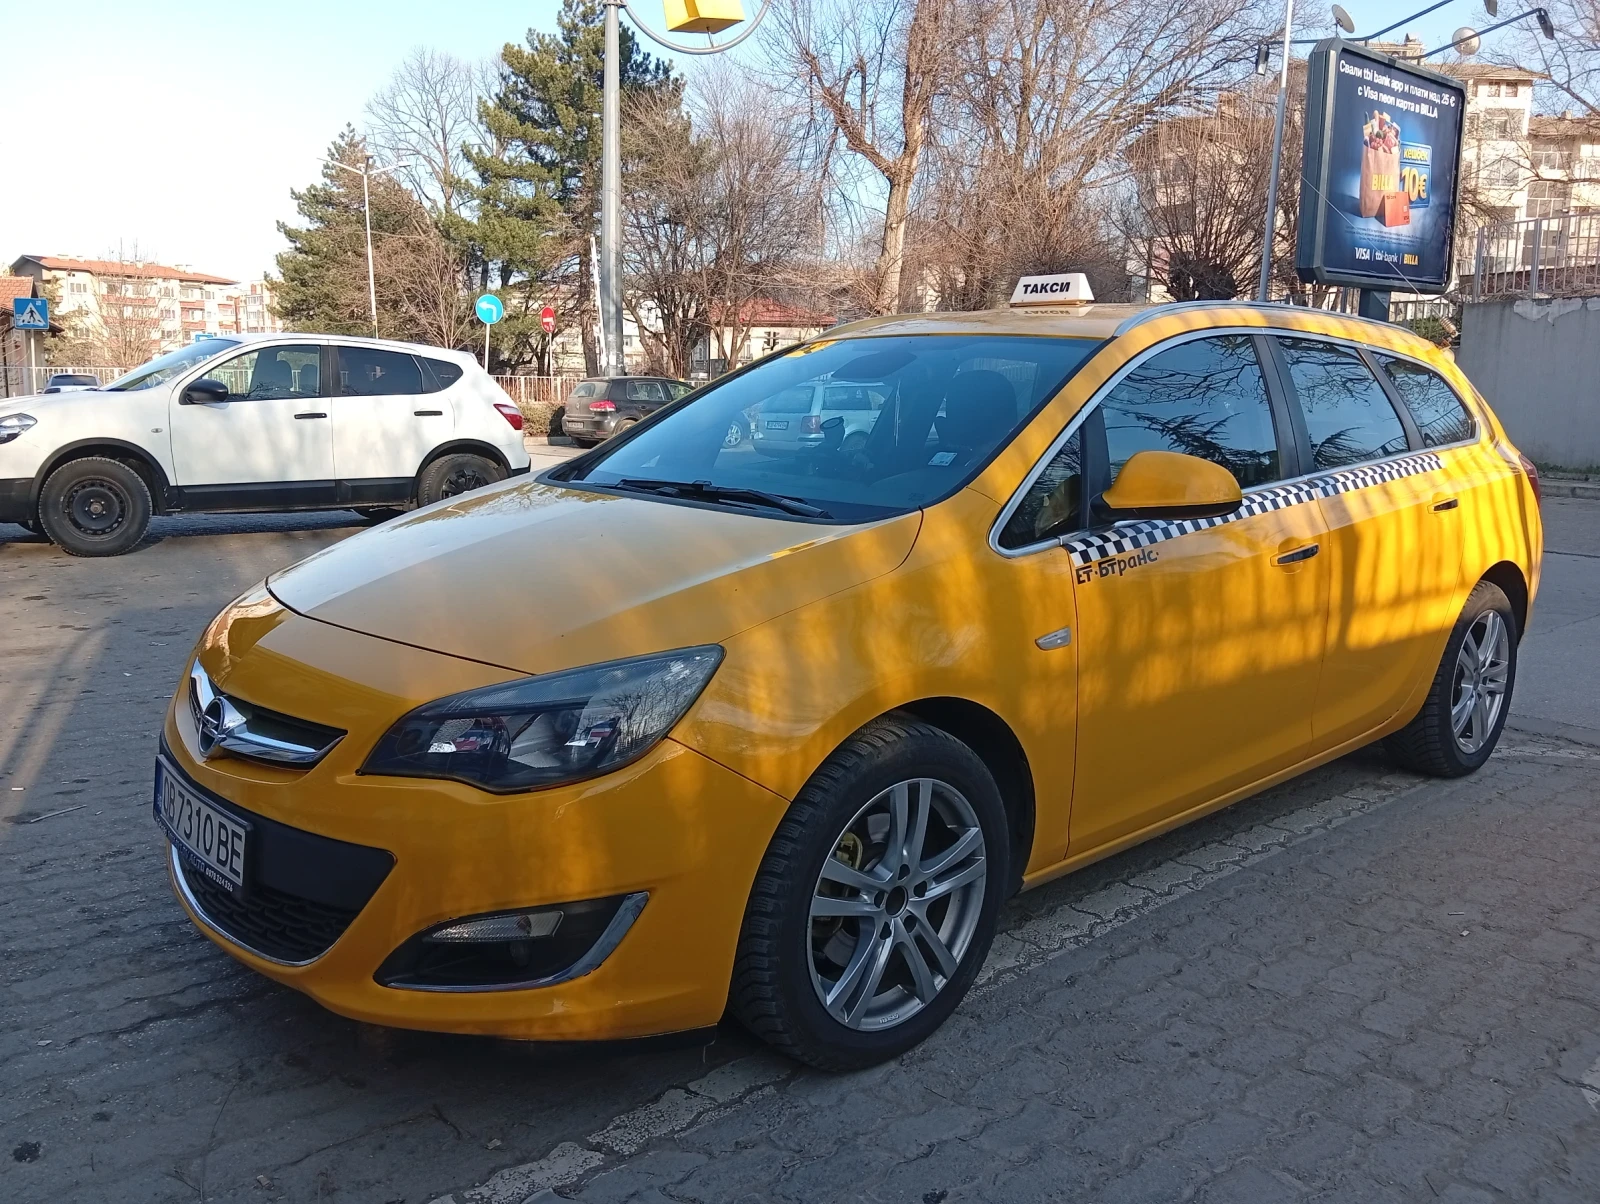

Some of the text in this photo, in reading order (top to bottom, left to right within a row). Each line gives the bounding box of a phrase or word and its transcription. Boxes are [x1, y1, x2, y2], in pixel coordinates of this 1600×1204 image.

[1340, 60, 1456, 107] Свали tbi bank app и плати над 25 €
[1363, 85, 1378, 100] Visa
[1379, 92, 1395, 106] neon
[1395, 99, 1414, 112] карта
[1415, 105, 1420, 113] в
[1421, 103, 1438, 118] BILLA
[1371, 174, 1394, 191] BILLA
[1354, 247, 1370, 261] VISA
[1403, 253, 1418, 266] BILLA
[1022, 282, 1071, 295] ТАКСИ
